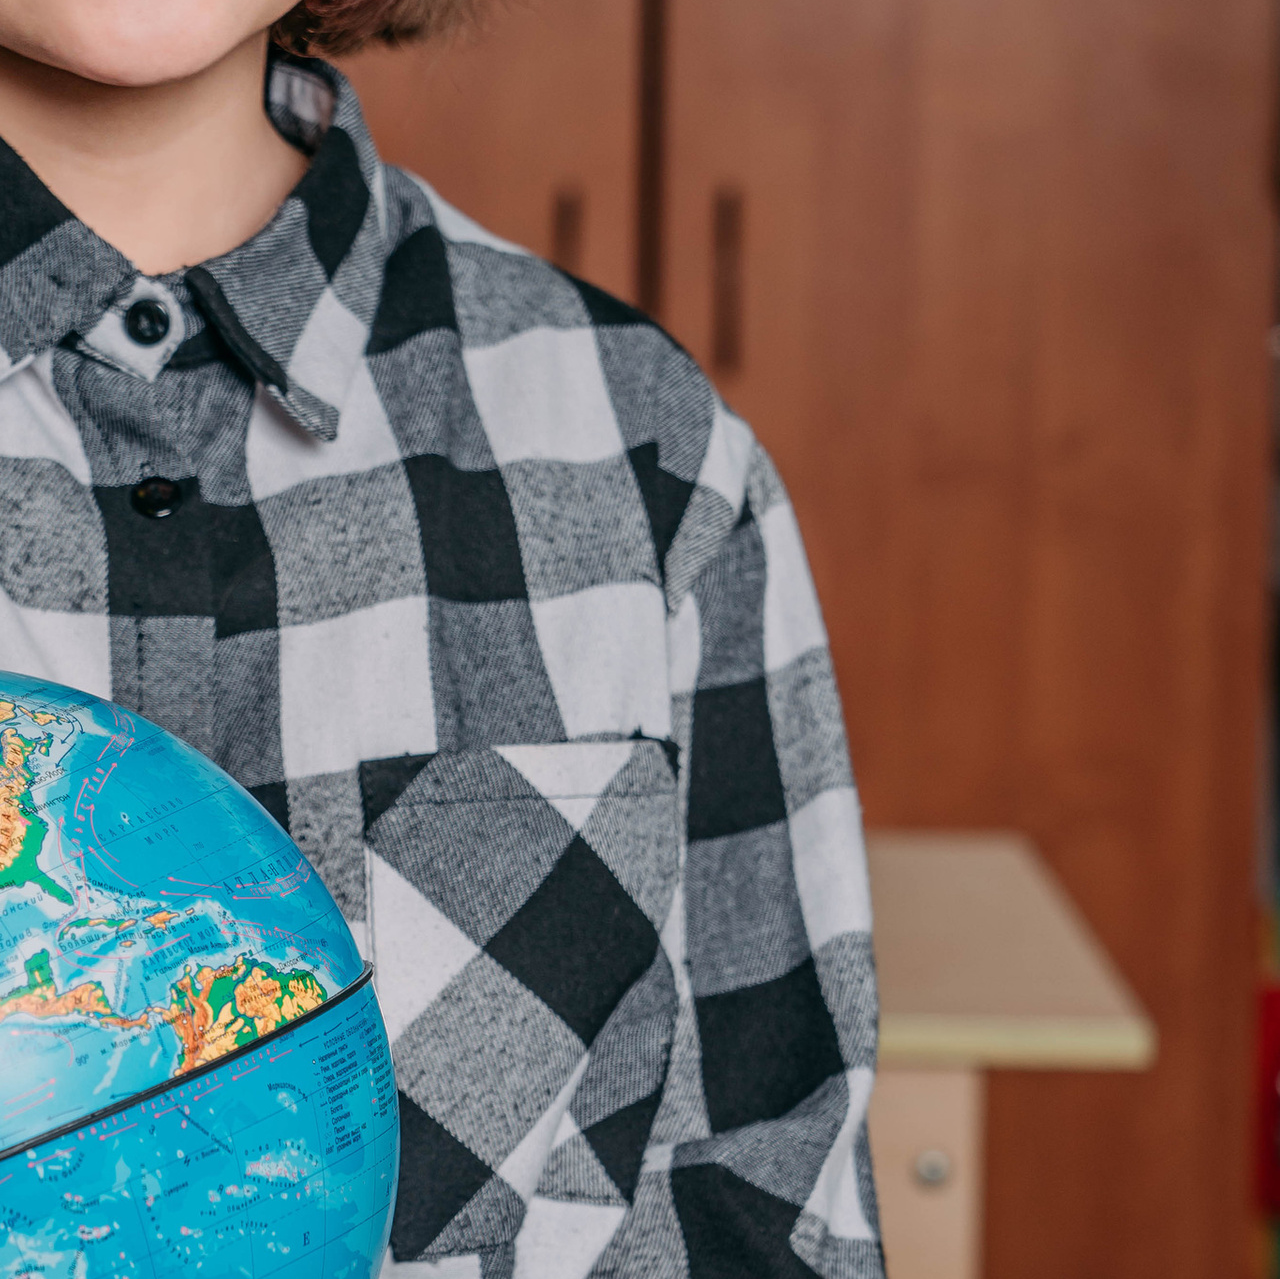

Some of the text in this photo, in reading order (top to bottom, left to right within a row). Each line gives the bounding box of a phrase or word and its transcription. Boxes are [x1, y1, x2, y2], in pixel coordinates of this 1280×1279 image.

[99, 797, 183, 842] САРГАССОВО
[145, 824, 179, 846] МОРЕ
[0, 928, 33, 950] залив
[58, 933, 108, 953] Большие
